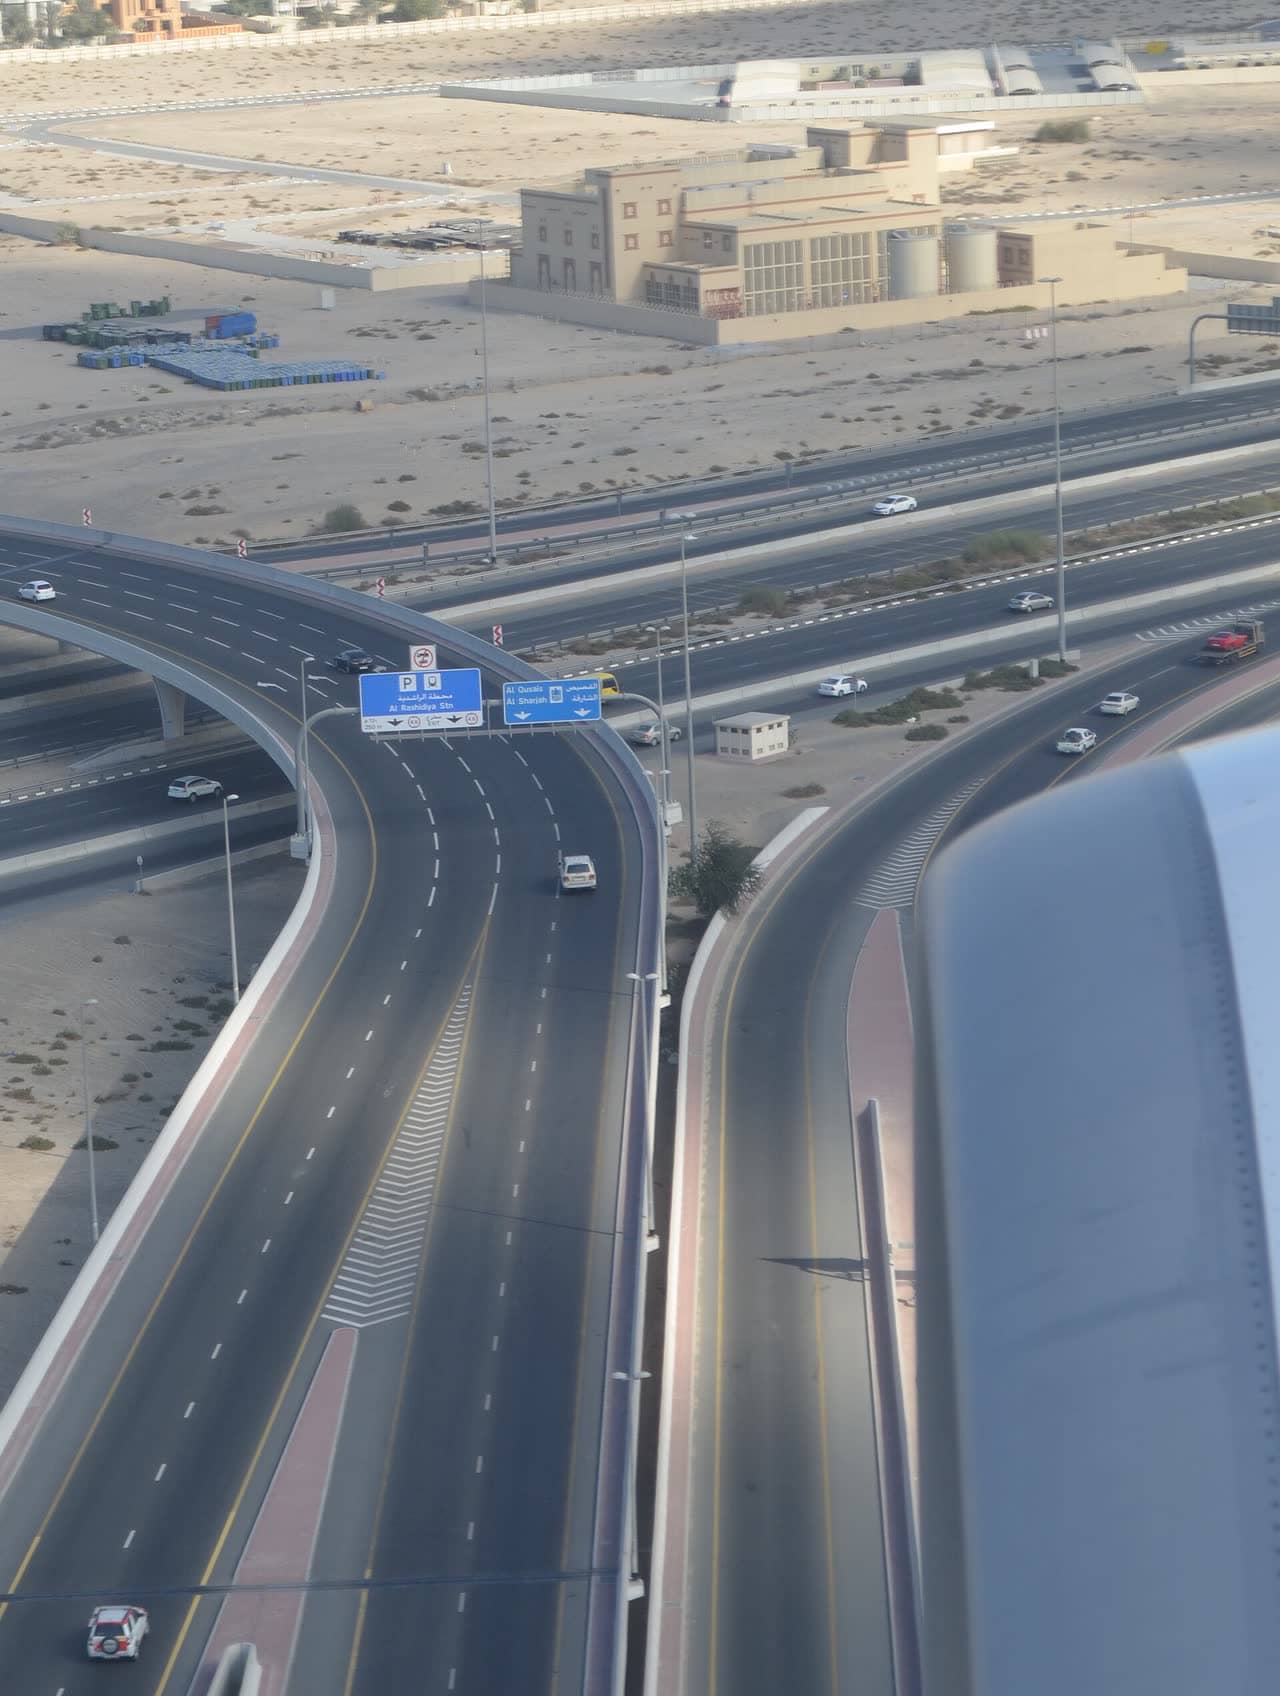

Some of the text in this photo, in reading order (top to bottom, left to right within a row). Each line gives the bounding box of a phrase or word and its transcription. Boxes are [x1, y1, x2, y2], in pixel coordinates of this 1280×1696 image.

[403, 677, 412, 690] P
[401, 703, 437, 712] Rashidiya
[439, 702, 454, 710] Stn
